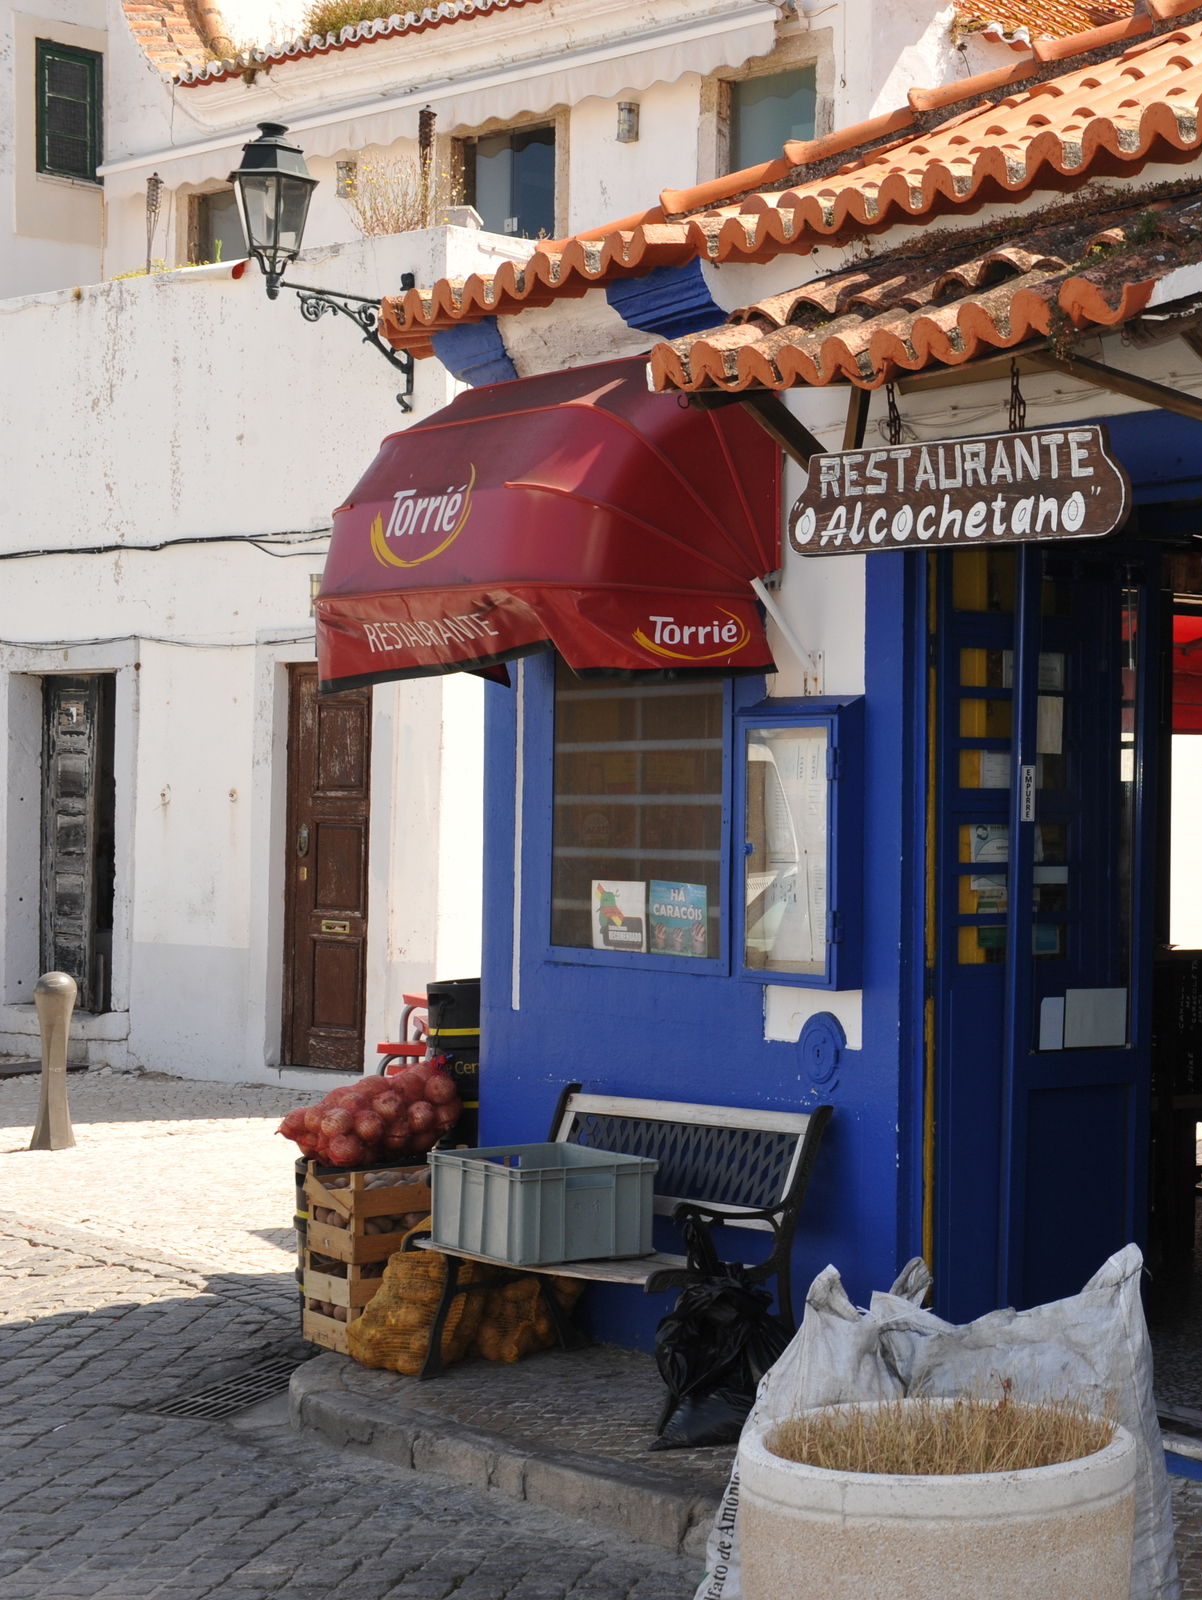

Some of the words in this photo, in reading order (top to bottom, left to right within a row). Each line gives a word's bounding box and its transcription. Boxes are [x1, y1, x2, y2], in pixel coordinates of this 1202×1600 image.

[818, 431, 1095, 499] RESTAURANTE
[385, 484, 467, 538] Torrié
[361, 612, 500, 654] RESTAURANTE
[648, 614, 739, 646] Torrié
[1024, 768, 1033, 819] EMPURRE
[670, 886, 686, 902] HÁ
[653, 903, 703, 921] CARACÓIS
[609, 931, 642, 942] RECOMENDADO
[715, 1540, 733, 1561] de
